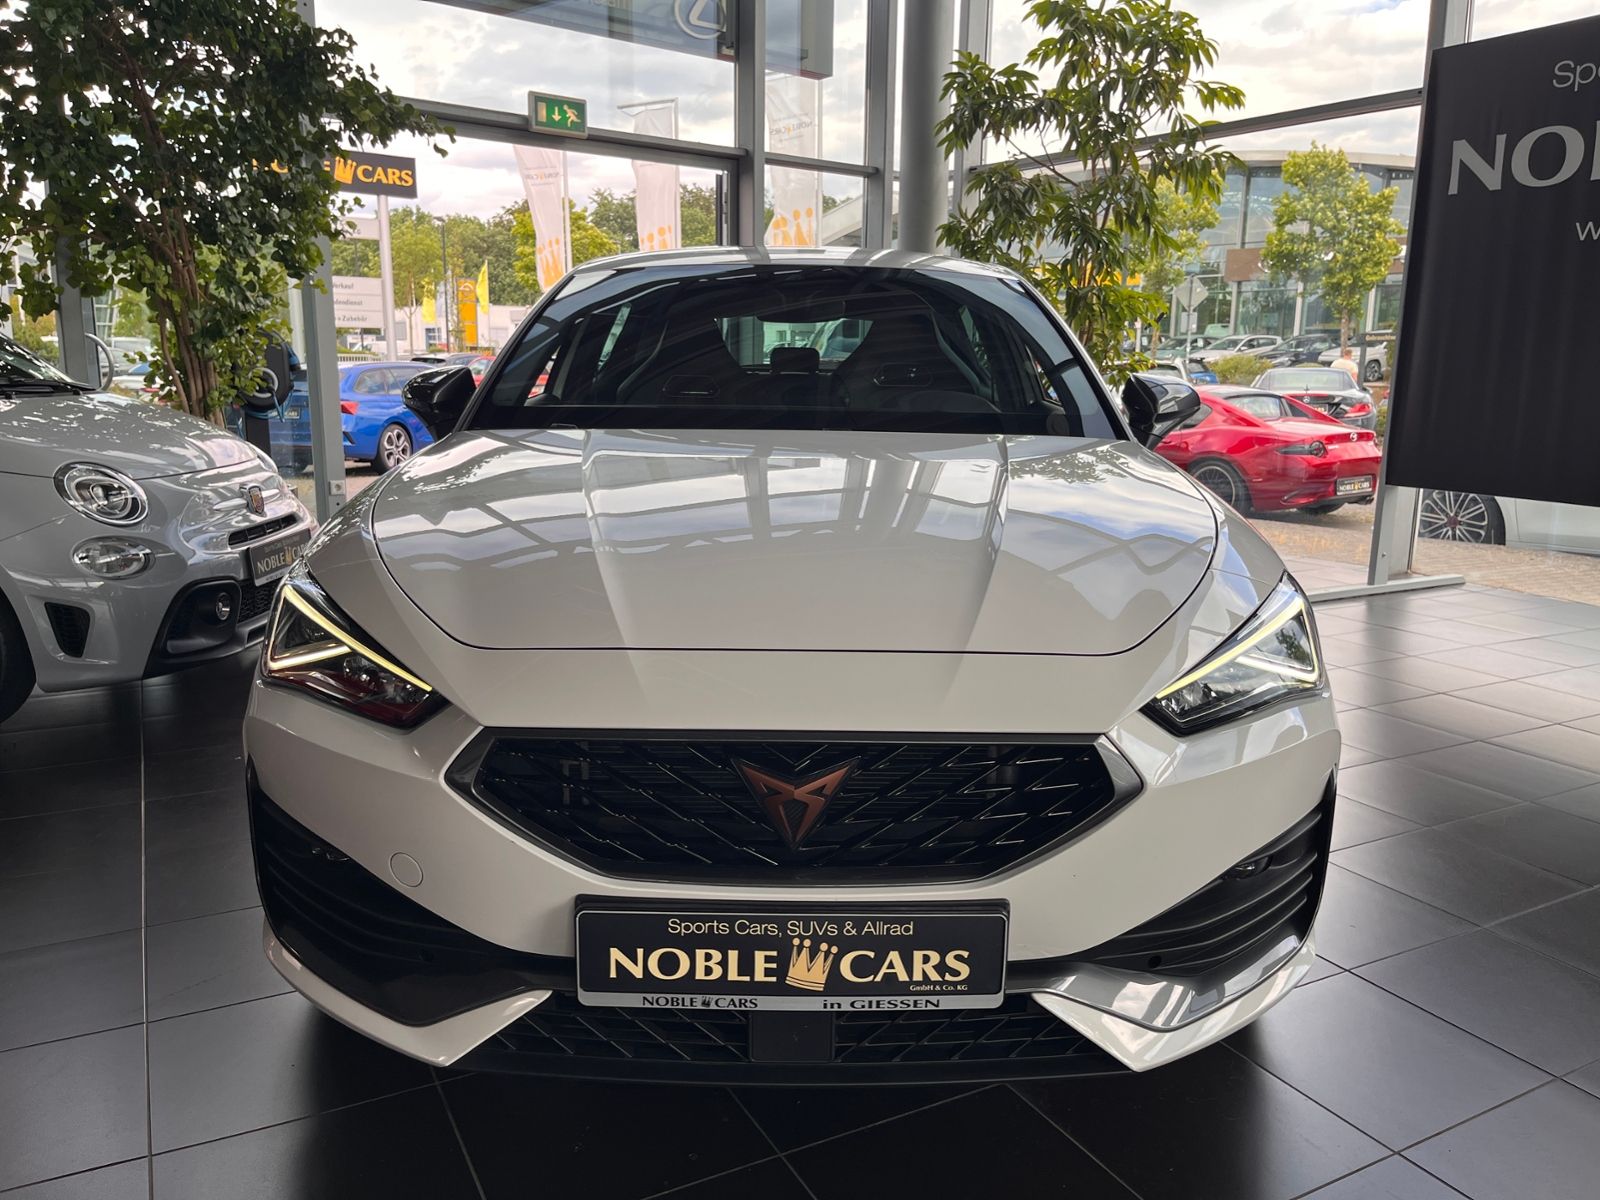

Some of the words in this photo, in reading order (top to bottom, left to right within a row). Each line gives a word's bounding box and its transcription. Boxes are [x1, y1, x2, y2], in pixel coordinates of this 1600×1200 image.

[1552, 60, 1600, 92] Sp
[356, 164, 415, 188] CARS
[257, 552, 285, 574] NOBLE
[668, 918, 730, 937] Sports
[734, 919, 782, 938] Cars,
[787, 920, 838, 936] SUVs
[843, 921, 857, 936] &
[861, 920, 914, 936] Allrad
[609, 947, 778, 982] NOBLE
[839, 949, 971, 983] CARS
[642, 996, 698, 1008] NOBLE
[715, 997, 758, 1009] CARS
[822, 999, 842, 1010] in
[850, 998, 940, 1010] GIESSEN
